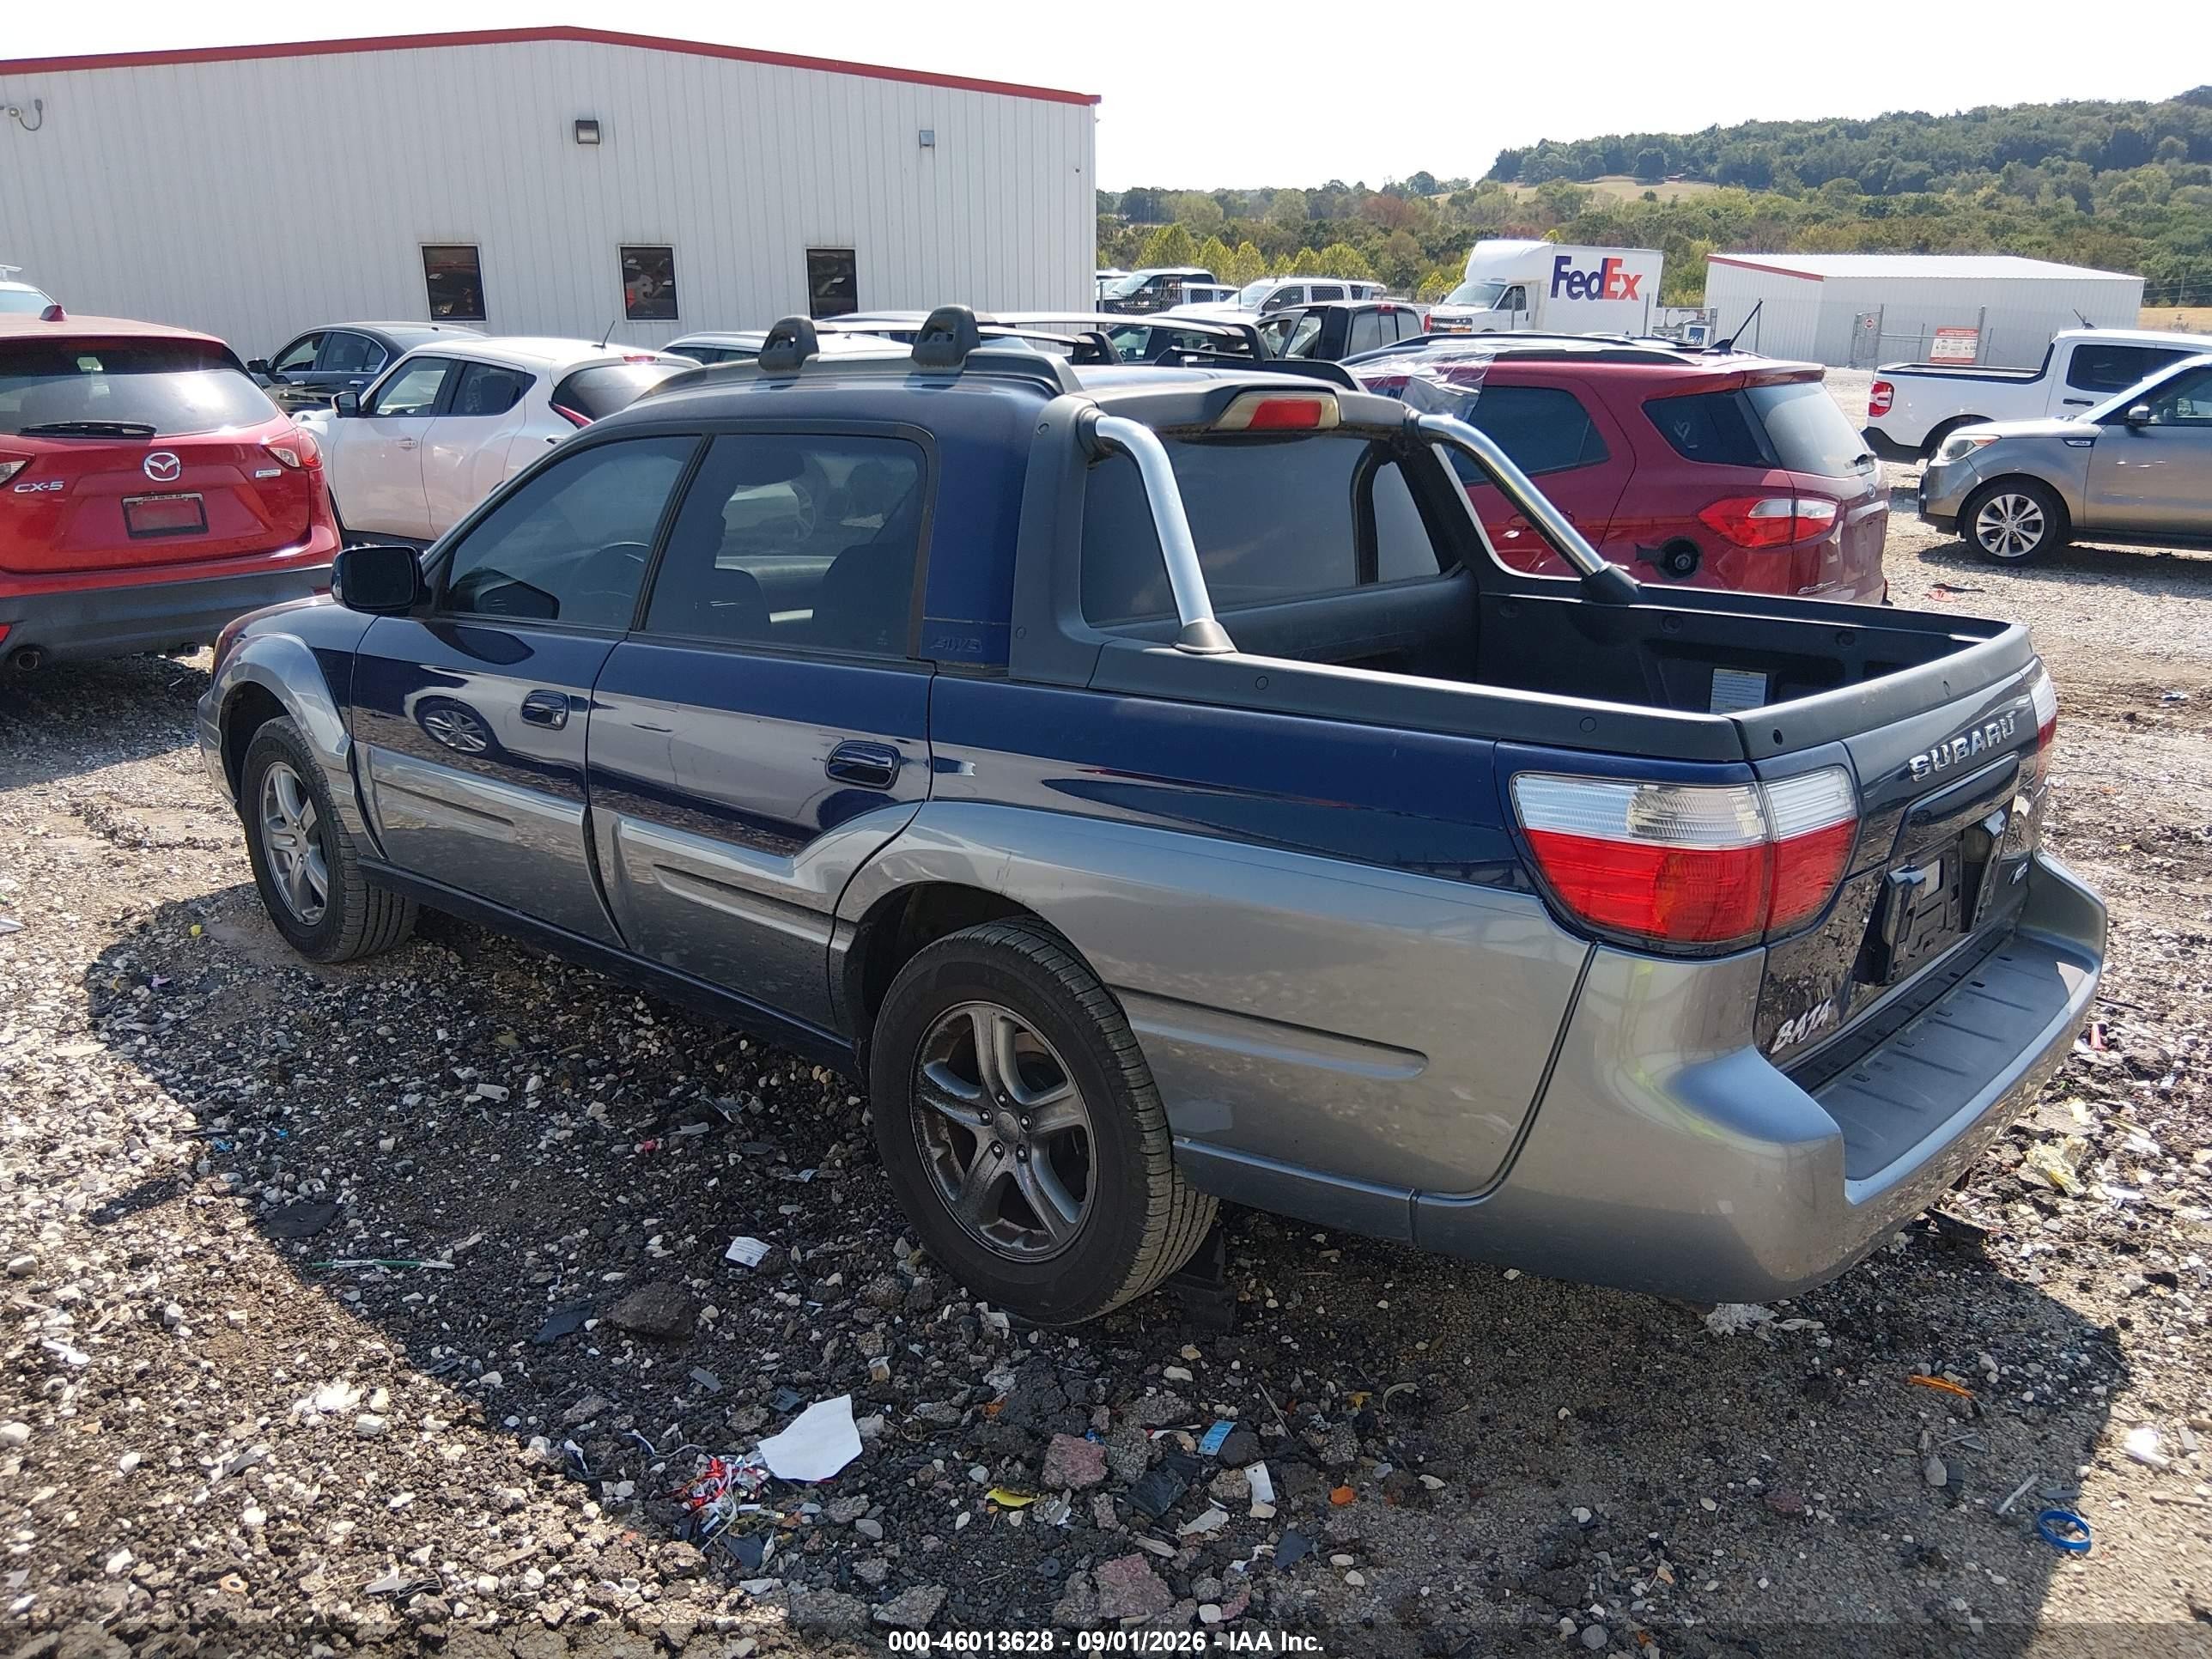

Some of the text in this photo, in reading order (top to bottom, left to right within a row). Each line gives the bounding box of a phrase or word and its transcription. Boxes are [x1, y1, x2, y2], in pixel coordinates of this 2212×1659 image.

[1549, 255, 1644, 301] FedEx
[14, 481, 65, 493] CX-5
[1908, 710, 2016, 782] SUBARU
[1770, 998, 1832, 1054] BAJA
